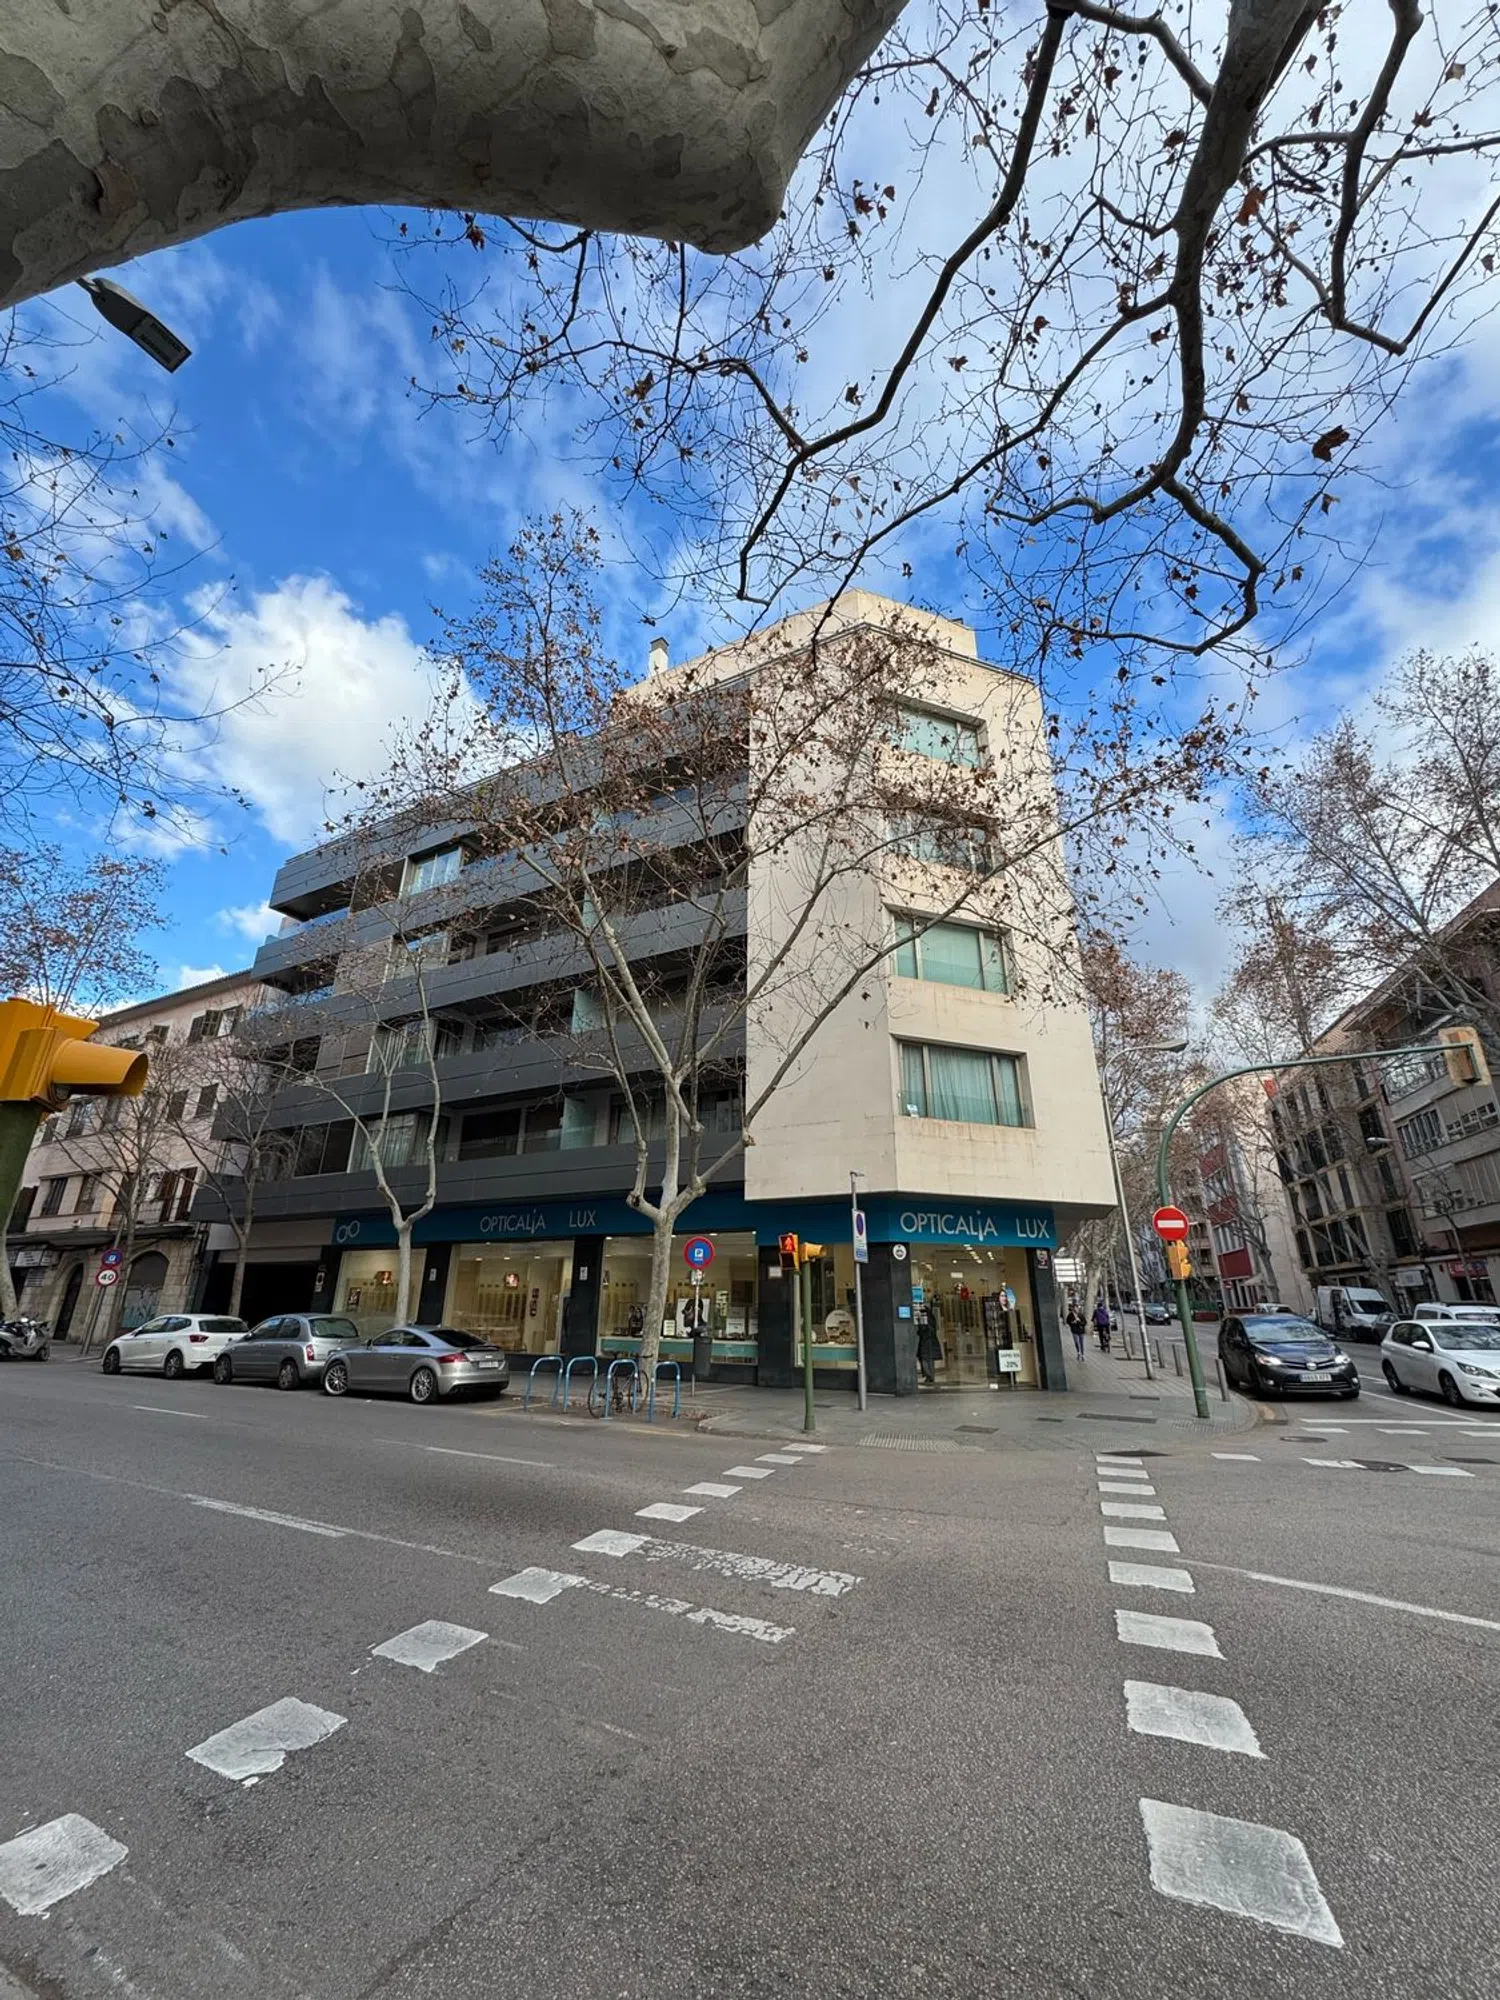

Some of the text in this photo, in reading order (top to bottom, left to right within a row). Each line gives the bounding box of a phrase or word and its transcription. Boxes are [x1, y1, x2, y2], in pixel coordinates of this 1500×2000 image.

[569, 1209, 597, 1229] LUX
[1015, 1217, 1050, 1239] LUX
[101, 1273, 114, 1281] 40
